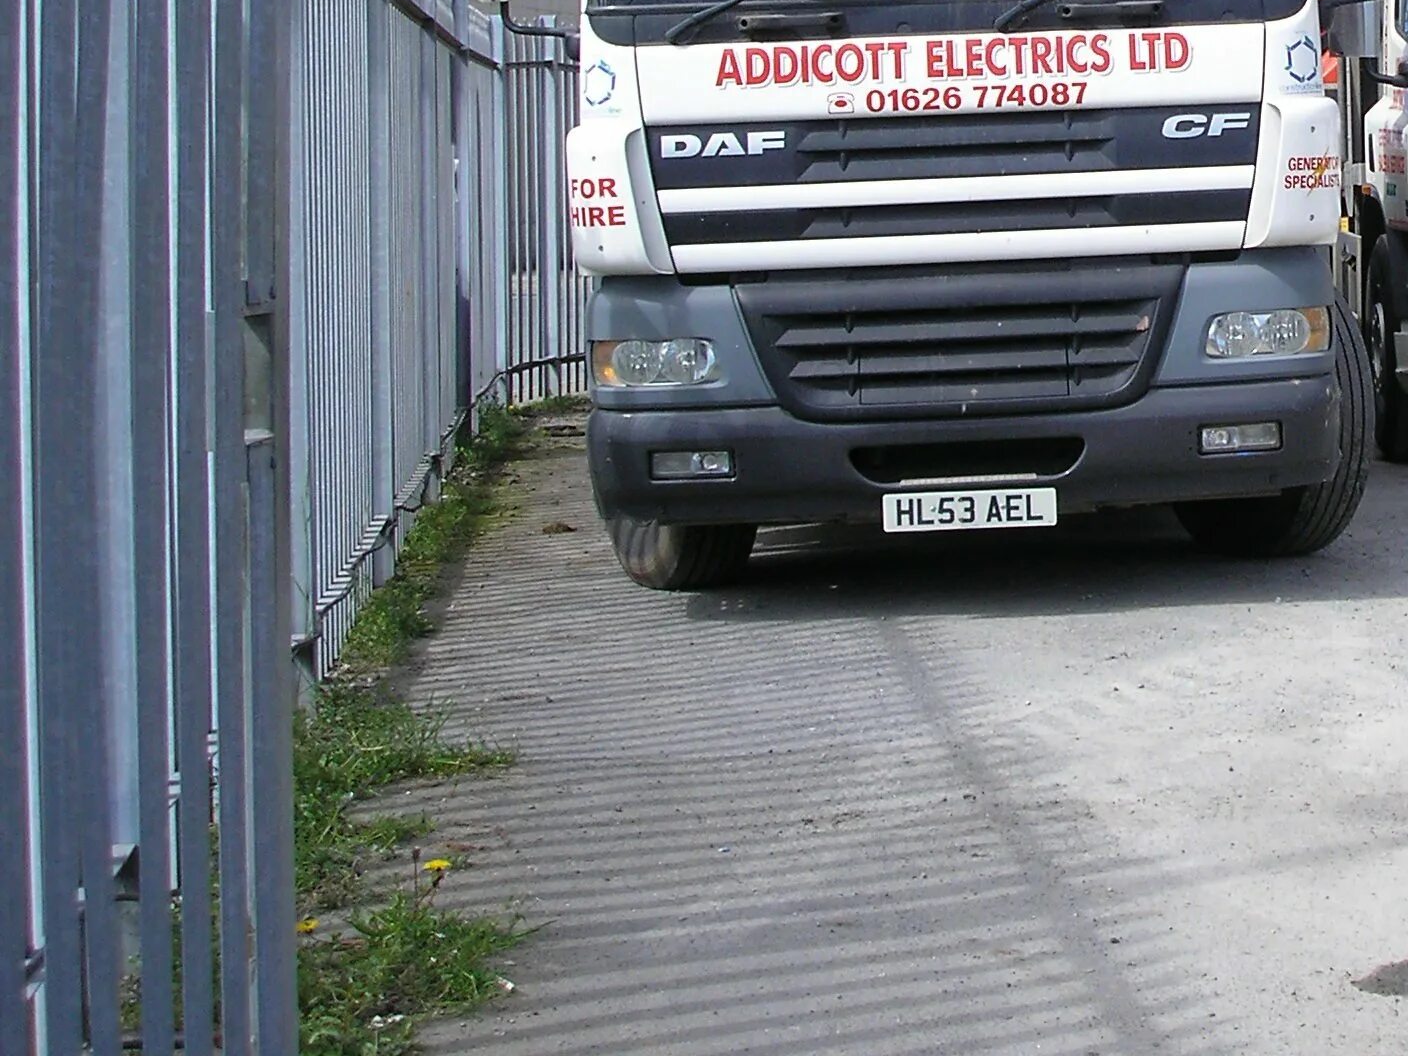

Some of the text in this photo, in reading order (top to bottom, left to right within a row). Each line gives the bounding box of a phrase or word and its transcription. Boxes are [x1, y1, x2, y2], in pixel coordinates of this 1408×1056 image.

[715, 32, 1192, 86] ADDICOTT ELECTRICS LTD
[866, 82, 1088, 112] 01626 774087
[1162, 112, 1251, 139] CF
[660, 131, 785, 158] DAF
[571, 178, 618, 198] FOR
[571, 206, 626, 227] HIRE
[896, 494, 1044, 526] HL53 AEL
